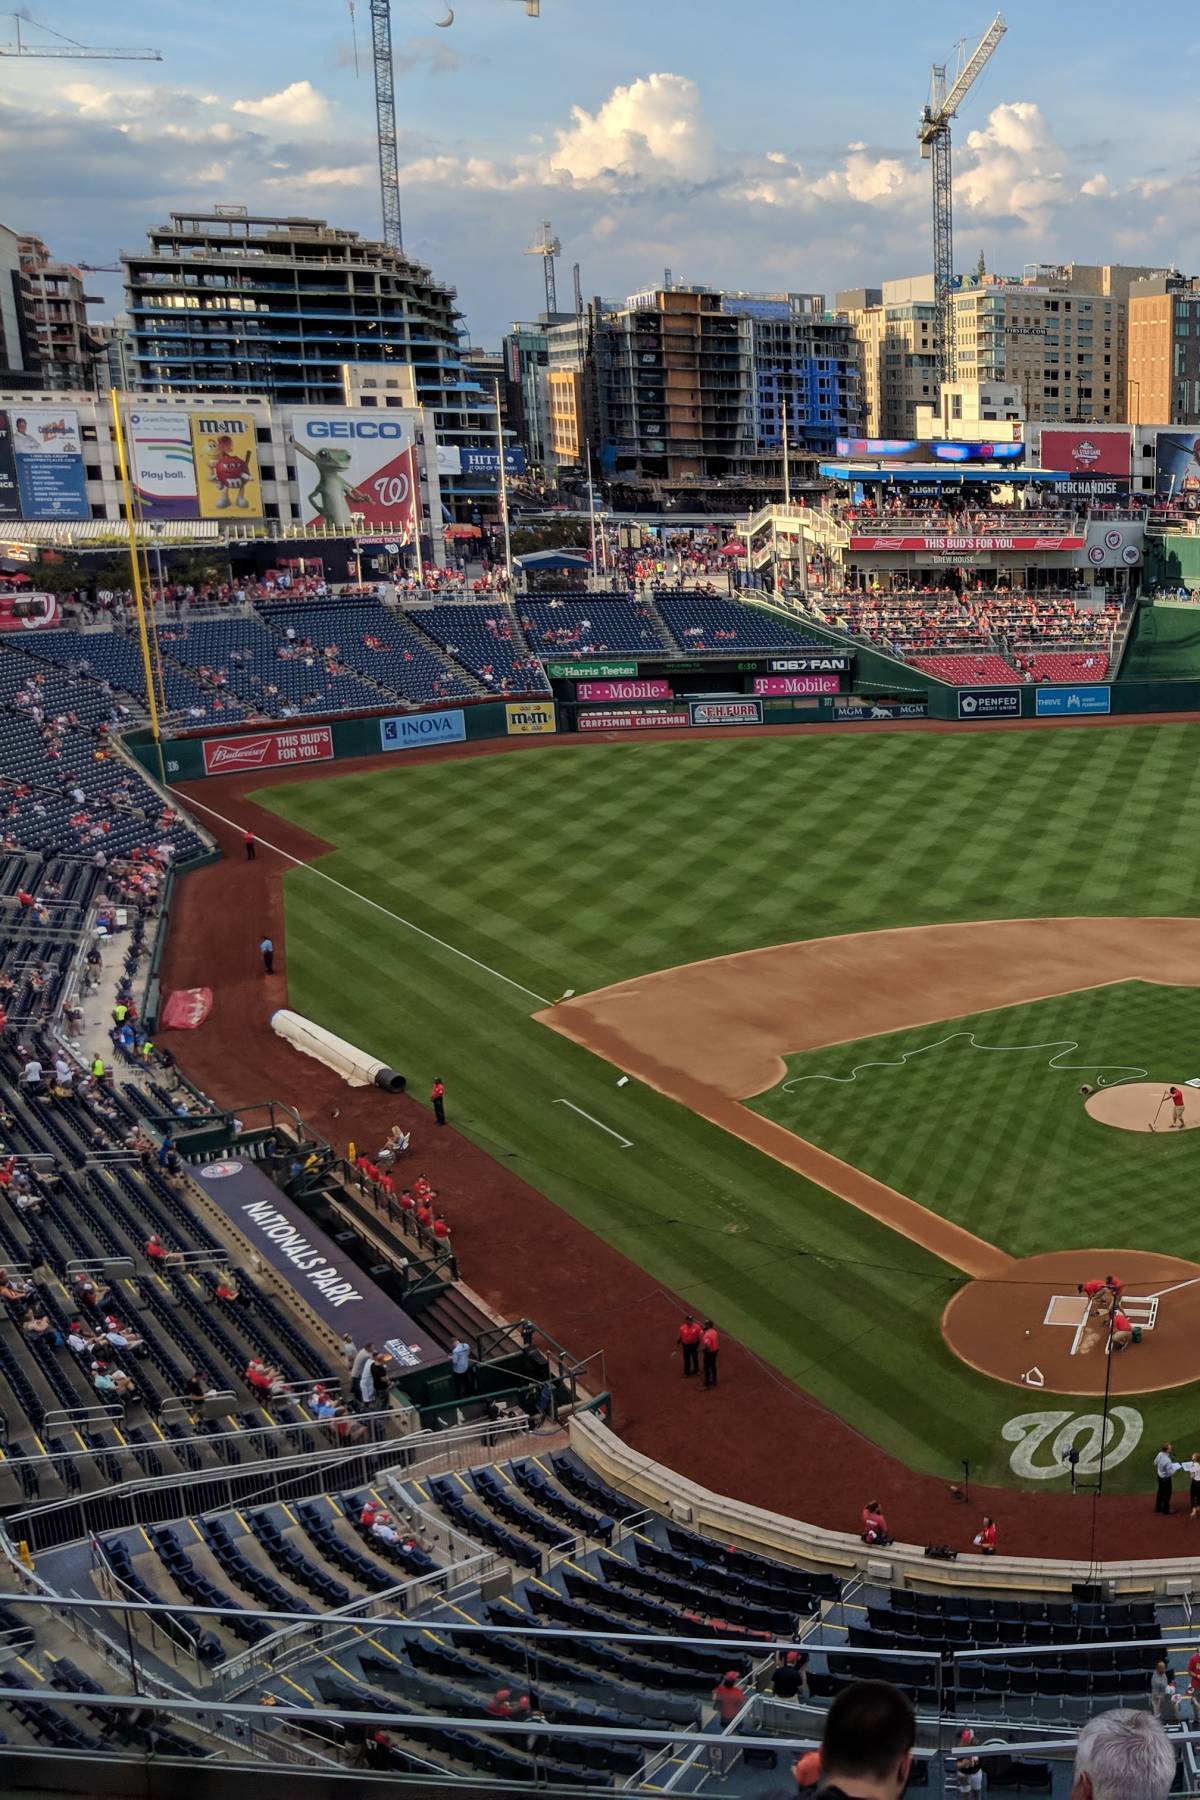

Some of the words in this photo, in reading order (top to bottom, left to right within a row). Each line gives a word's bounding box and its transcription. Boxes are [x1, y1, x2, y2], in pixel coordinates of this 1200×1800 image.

[306, 421, 402, 439] GEICO
[141, 471, 163, 480] Play
[165, 471, 187, 479] ball.
[1055, 481, 1117, 494] MERCHANDISE
[924, 538, 944, 549] THIS
[946, 538, 974, 549] BUD'S
[976, 538, 993, 549] FOR
[995, 538, 1015, 549] YOU.
[933, 555, 952, 564] BREW
[953, 555, 974, 564] HOUSE
[810, 659, 845, 670] FAN
[564, 667, 599, 677] Harris
[601, 666, 635, 676] Teeter
[979, 698, 1017, 706] PENFED
[838, 707, 863, 716] MGM
[900, 704, 925, 714] MGM
[402, 717, 452, 736] INOVA
[581, 718, 632, 728] CRAFTSMAN
[635, 716, 686, 725] CRAFTSMAN
[276, 735, 299, 748] THIS
[300, 731, 329, 746] BUD'S
[213, 744, 266, 762] Budweiser
[278, 748, 298, 760] FOR
[299, 745, 321, 758] YOU.
[241, 1200, 327, 1270] NATIONALS
[306, 1265, 363, 1308] PARK
